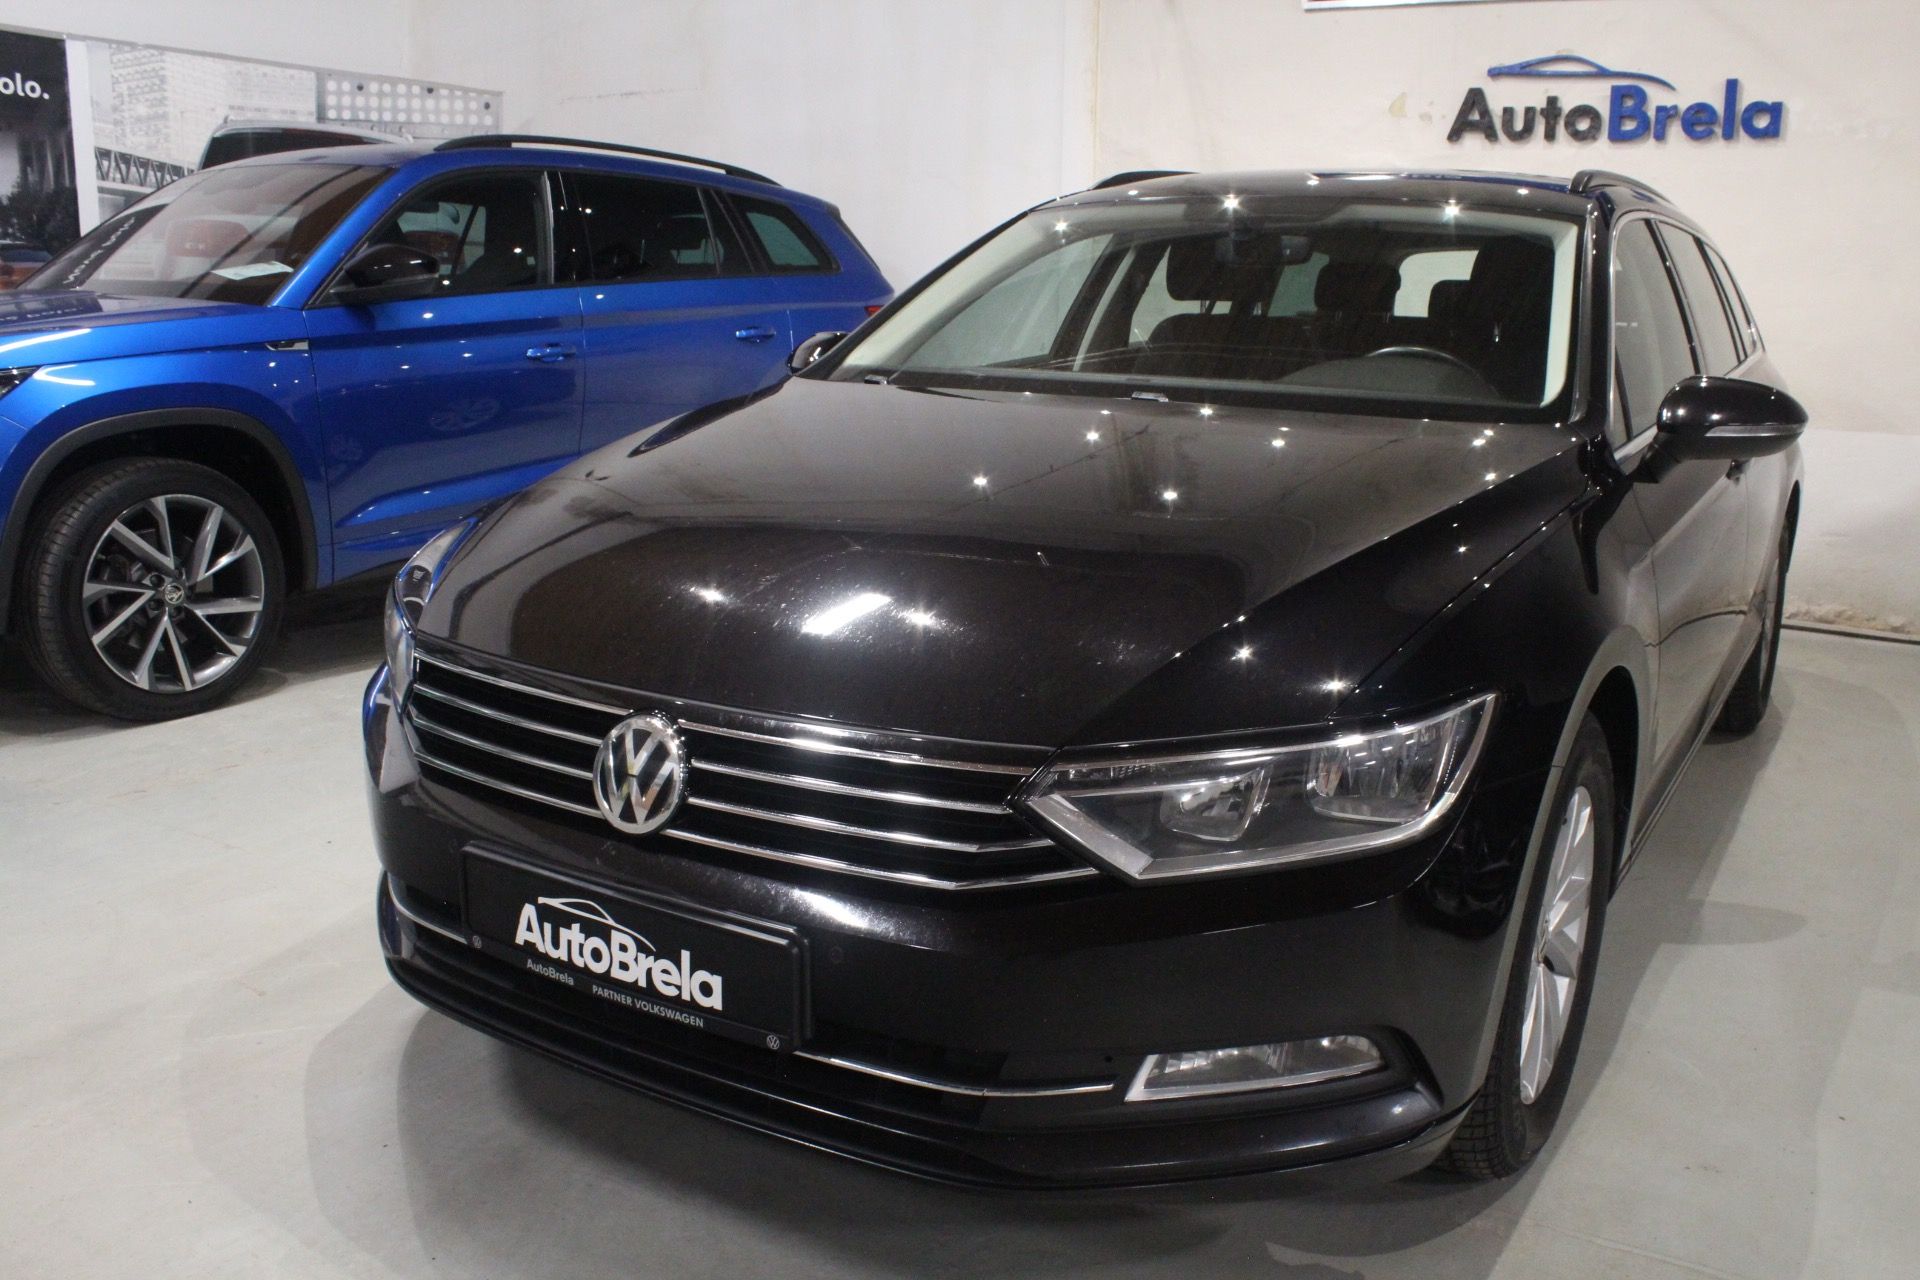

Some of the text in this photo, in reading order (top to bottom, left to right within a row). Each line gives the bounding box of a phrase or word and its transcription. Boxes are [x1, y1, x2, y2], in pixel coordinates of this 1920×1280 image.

[1446, 78, 1785, 143] AutoBrela
[514, 902, 723, 1011] AutoBrela
[526, 958, 575, 987] AutoBrela
[592, 984, 704, 1029] PARTNER VOLKSWAGEN
